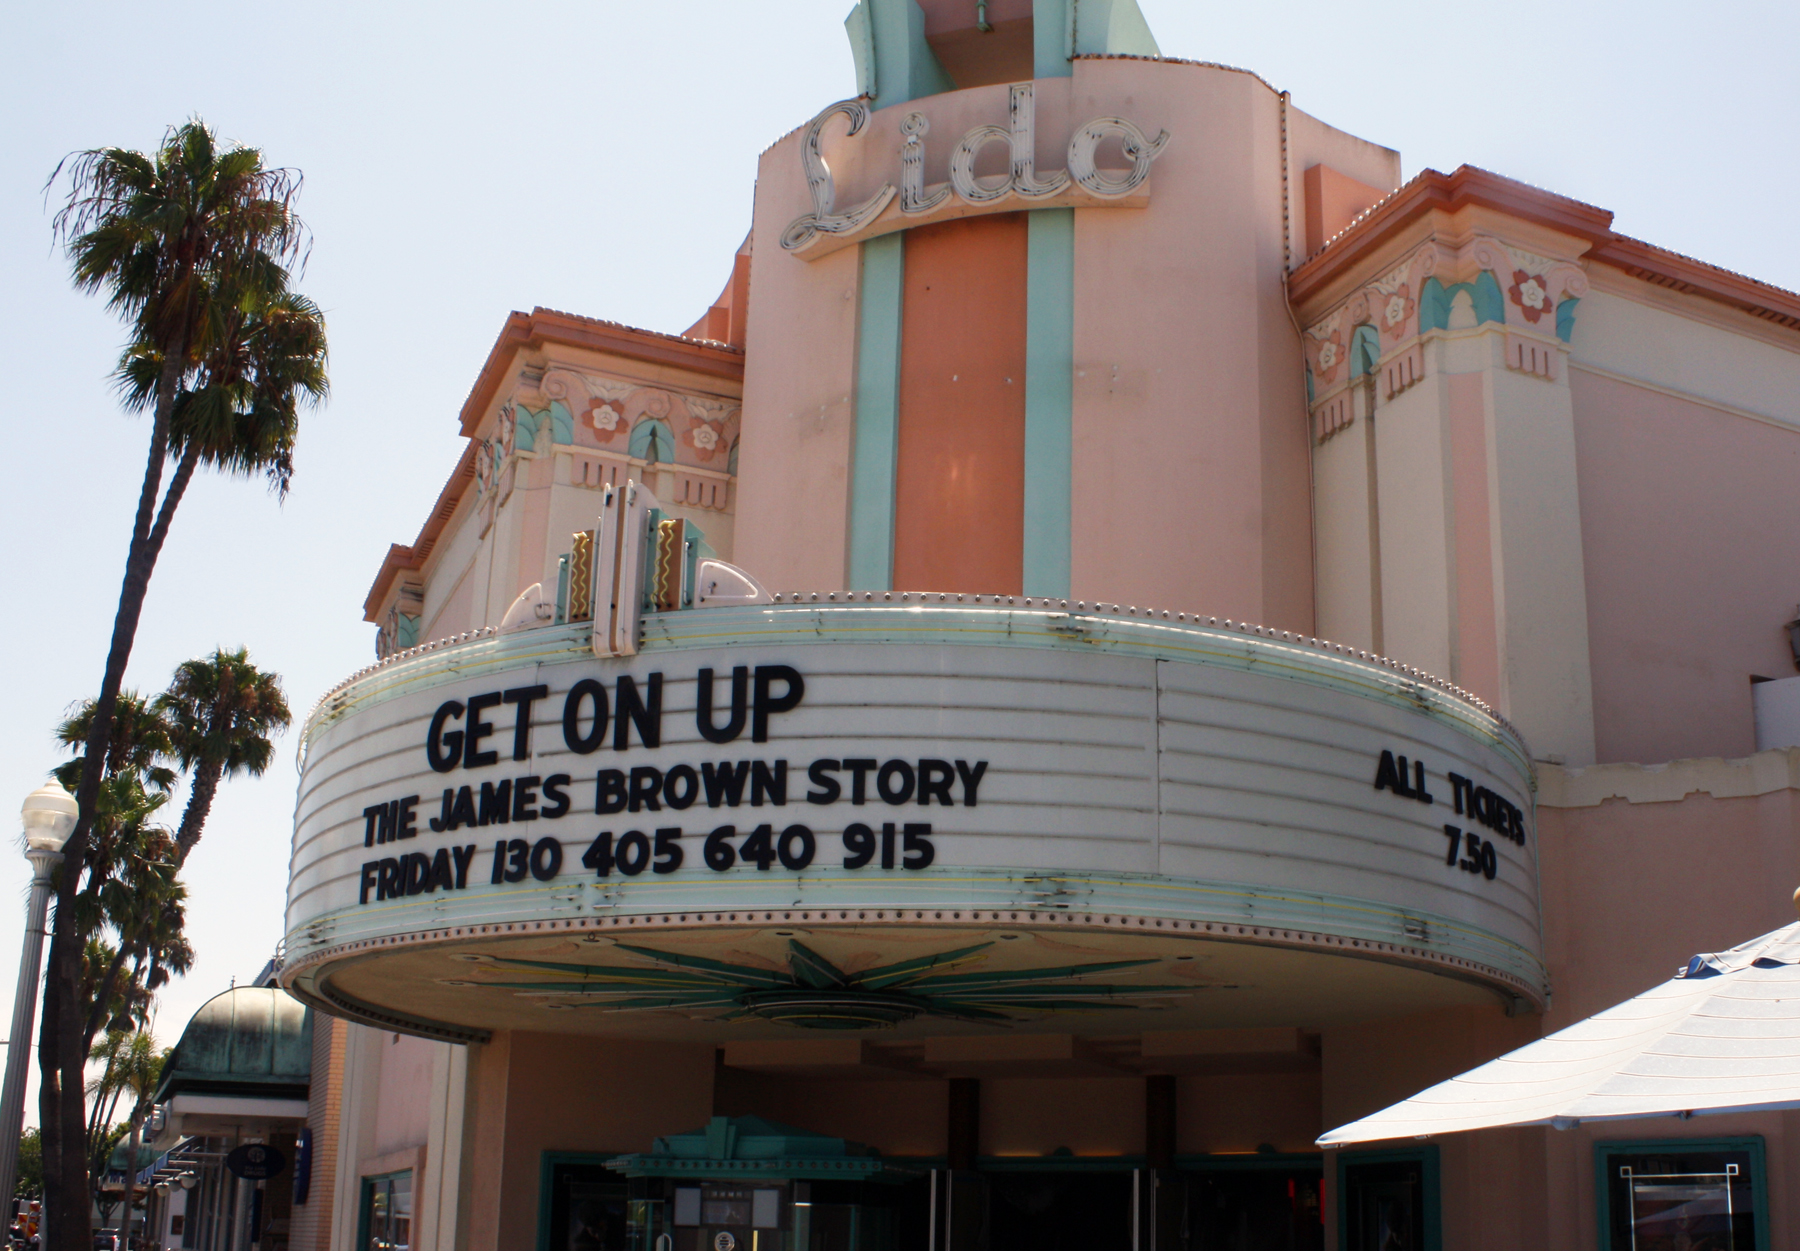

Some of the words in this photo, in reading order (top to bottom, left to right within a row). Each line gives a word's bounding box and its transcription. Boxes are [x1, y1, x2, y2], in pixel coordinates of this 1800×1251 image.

[780, 82, 1171, 250] Lido
[426, 683, 548, 773] GET
[562, 671, 663, 756] ON
[695, 664, 805, 745] UP
[362, 794, 420, 848] THE
[429, 773, 571, 832] JAMES
[594, 759, 788, 815] BROWN
[806, 758, 988, 807] STORY
[1374, 749, 1433, 805] ALL
[1448, 771, 1526, 847] TICKETS
[359, 843, 476, 905] FRIDAY
[491, 836, 563, 886] 130
[581, 827, 684, 878] 405
[701, 823, 816, 872] 640
[842, 822, 935, 871] 915
[1444, 823, 1497, 880] 7.50
